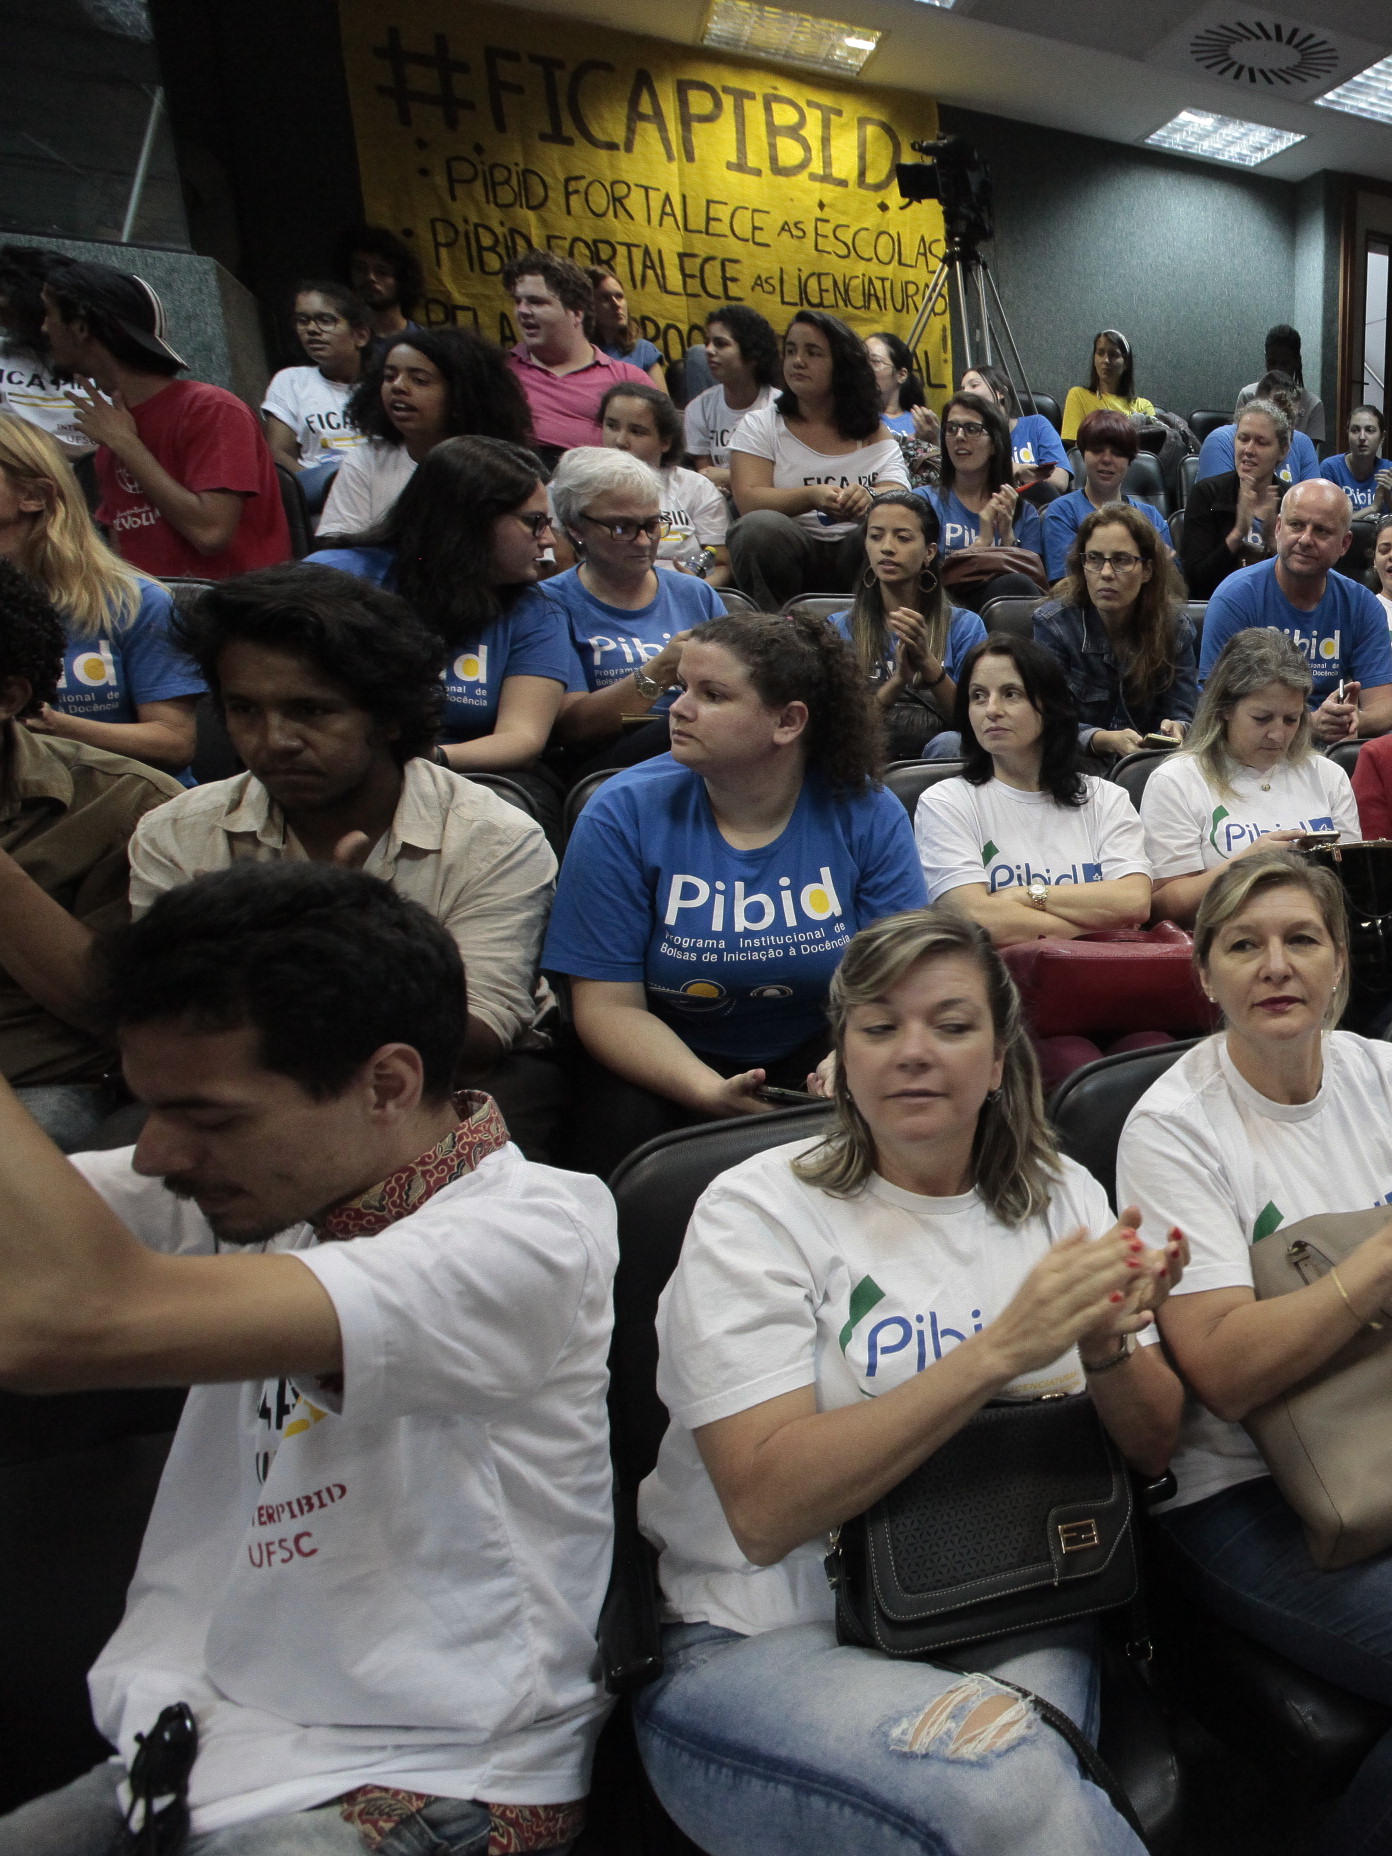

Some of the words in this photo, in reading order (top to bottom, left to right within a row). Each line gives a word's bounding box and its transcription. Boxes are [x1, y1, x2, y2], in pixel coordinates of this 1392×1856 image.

[563, 174, 771, 248] FORTALECE
[778, 219, 806, 240] AS
[813, 217, 942, 274] ESCOLAS
[751, 273, 776, 295] AS
[106, 691, 120, 700] de
[475, 687, 488, 696] de
[990, 862, 1079, 893] Pibid
[664, 866, 843, 933] Pibid
[660, 942, 697, 962] Bolsas
[702, 951, 718, 962] de
[723, 948, 784, 962] Iniciação
[788, 946, 797, 957] à
[801, 934, 851, 955] Docência
[665, 929, 726, 950] Programa
[739, 927, 826, 948] Institucional
[834, 921, 847, 934] de
[248, 1531, 320, 1569] UFSC
